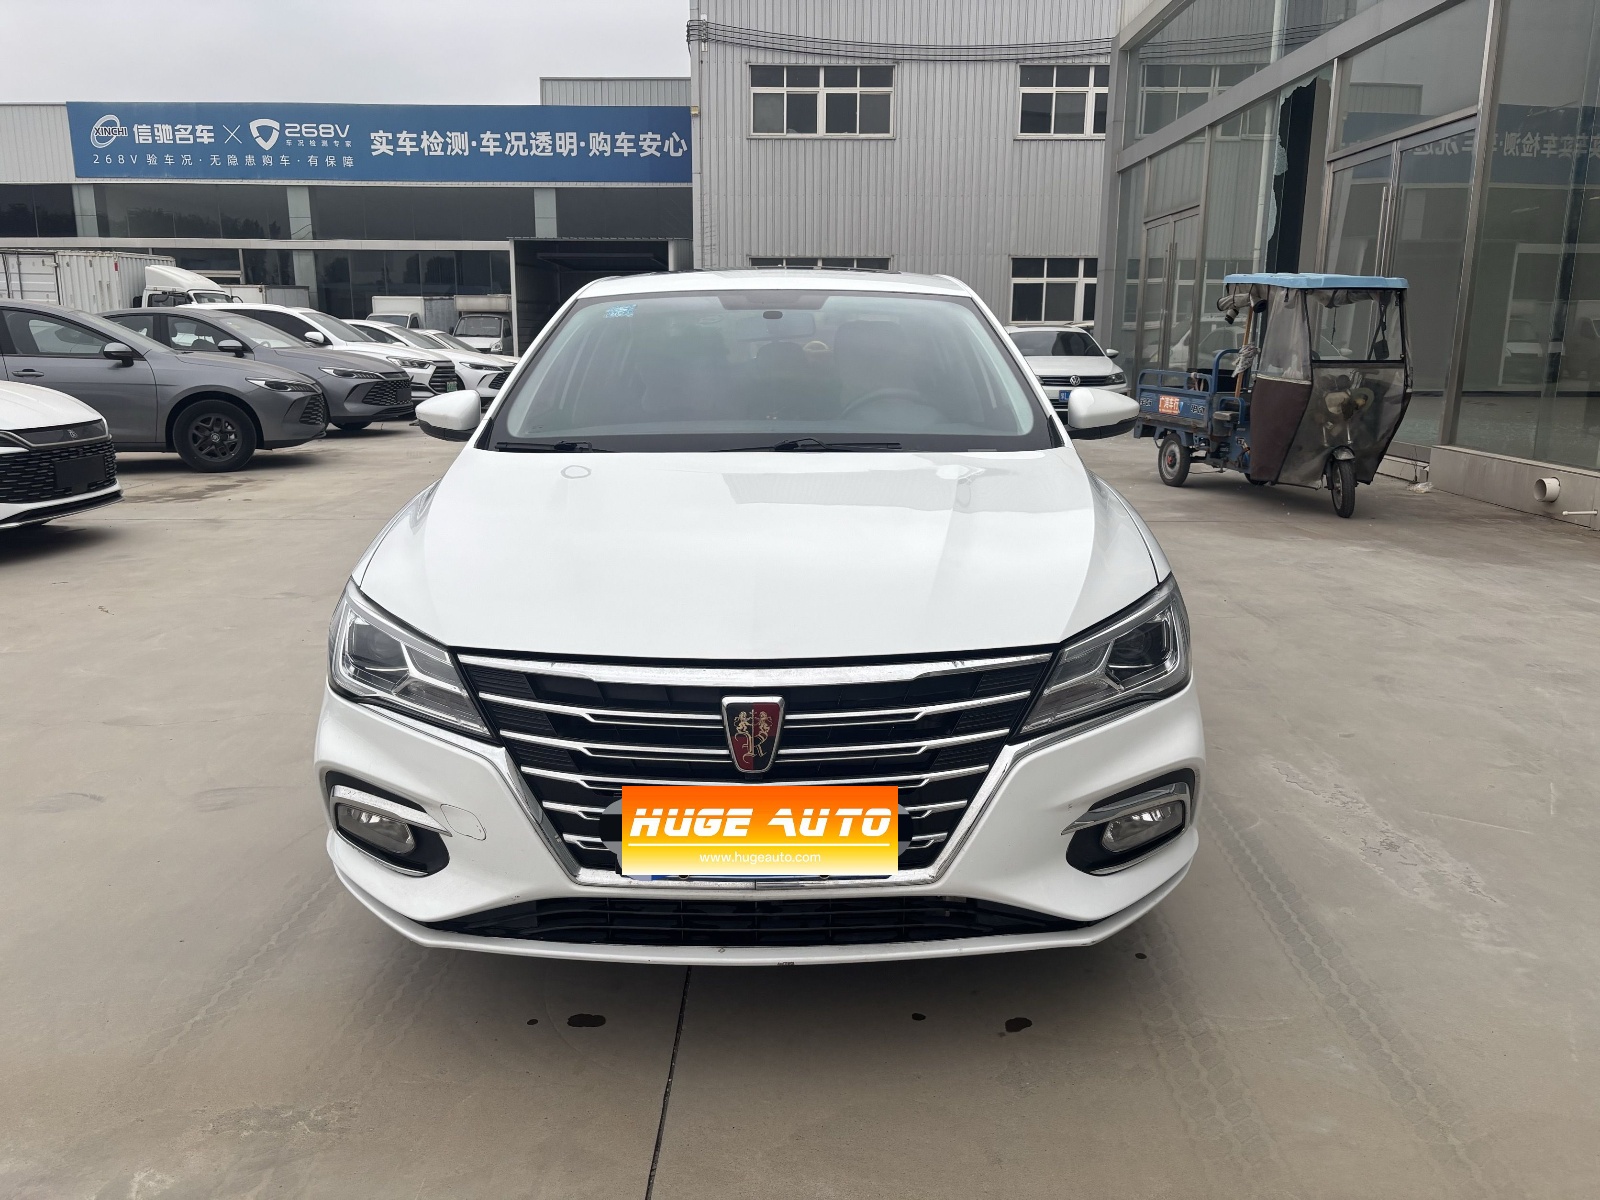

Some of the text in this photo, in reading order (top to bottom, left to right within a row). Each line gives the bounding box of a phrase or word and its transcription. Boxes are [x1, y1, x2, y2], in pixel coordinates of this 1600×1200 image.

[95, 127, 128, 136] XINCHI
[133, 123, 215, 144] 信驰名车
[284, 123, 350, 138] 268V
[285, 139, 352, 148] 车况检测专家
